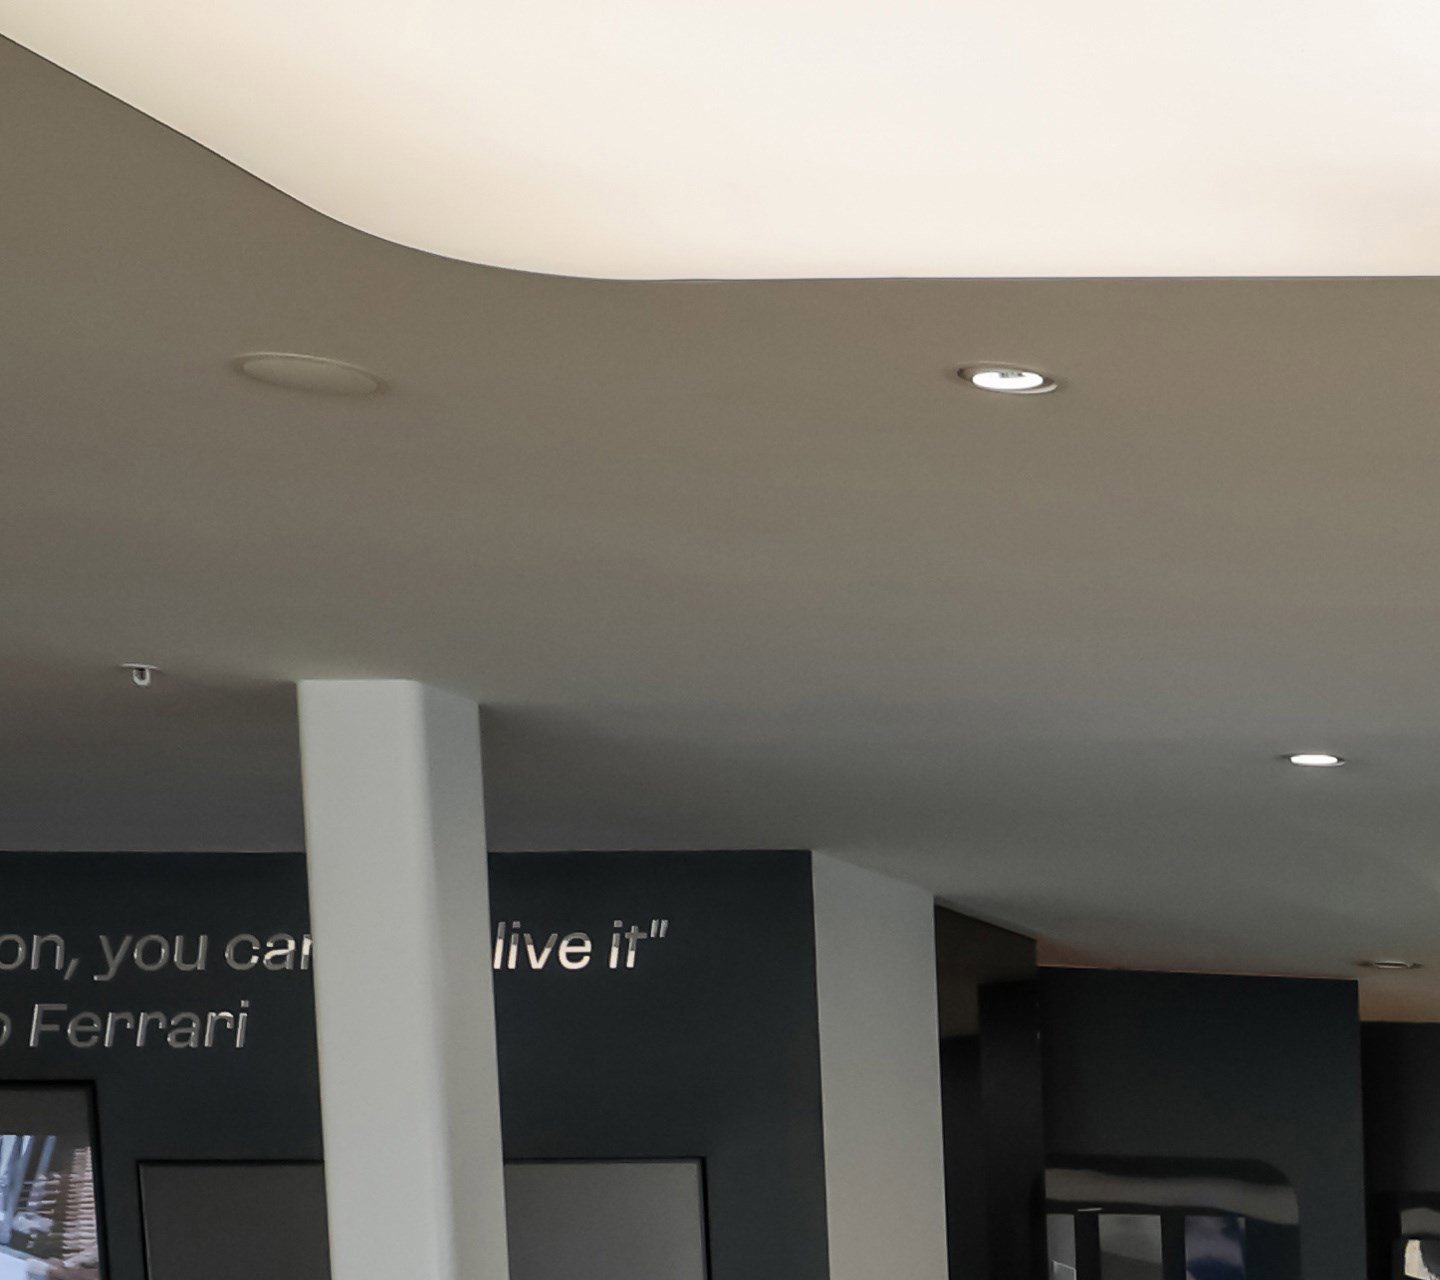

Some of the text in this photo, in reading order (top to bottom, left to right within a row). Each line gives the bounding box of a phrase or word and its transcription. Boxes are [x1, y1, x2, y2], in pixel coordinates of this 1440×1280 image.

[93, 934, 208, 981] you
[493, 920, 592, 970] live
[29, 1000, 249, 1048] Ferrari
